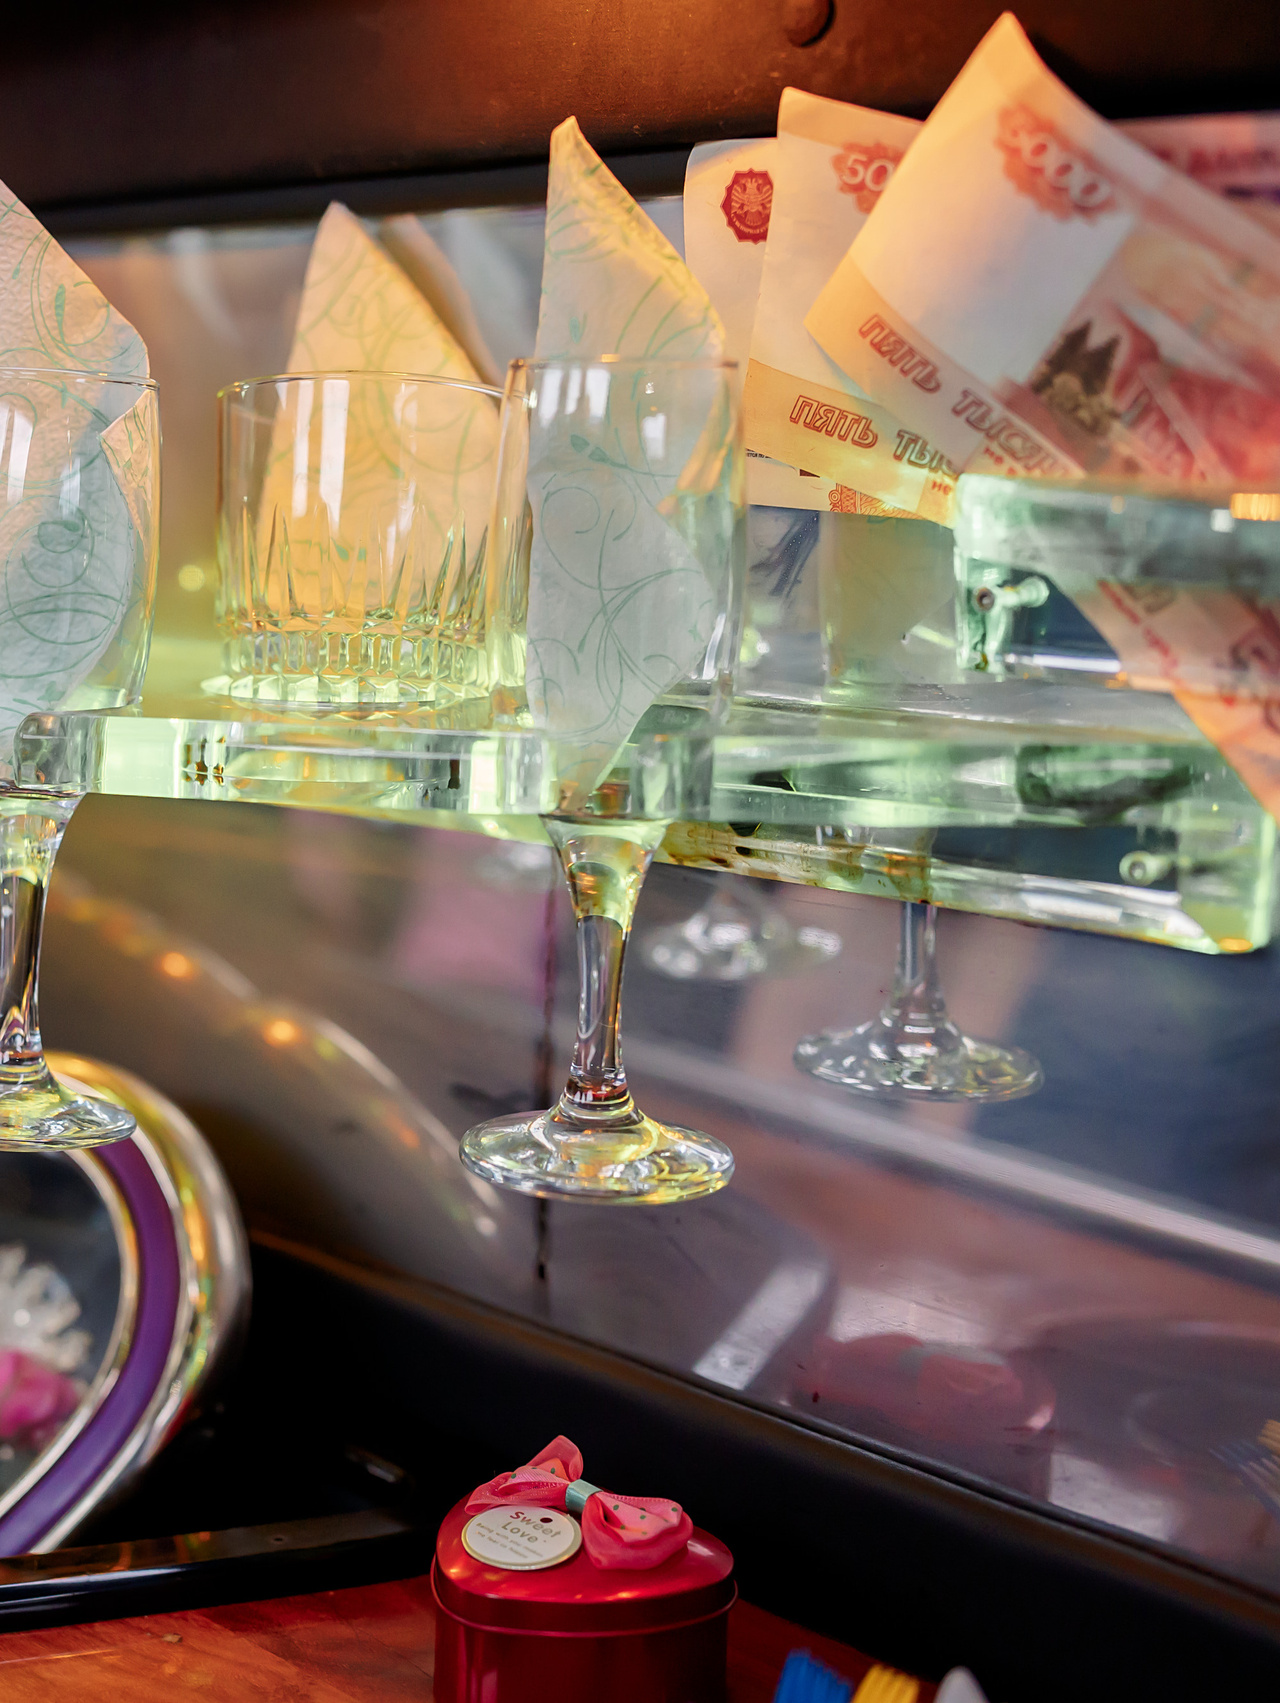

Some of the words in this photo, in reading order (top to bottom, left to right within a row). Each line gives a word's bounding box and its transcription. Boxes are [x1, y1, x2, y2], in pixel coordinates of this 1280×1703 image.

[841, 153, 895, 192] 50
[859, 313, 941, 394] ПЯТЬ
[789, 394, 879, 449] ПЯТЬ
[501, 1521, 538, 1543] Love
[509, 1511, 562, 1538] Sweet
